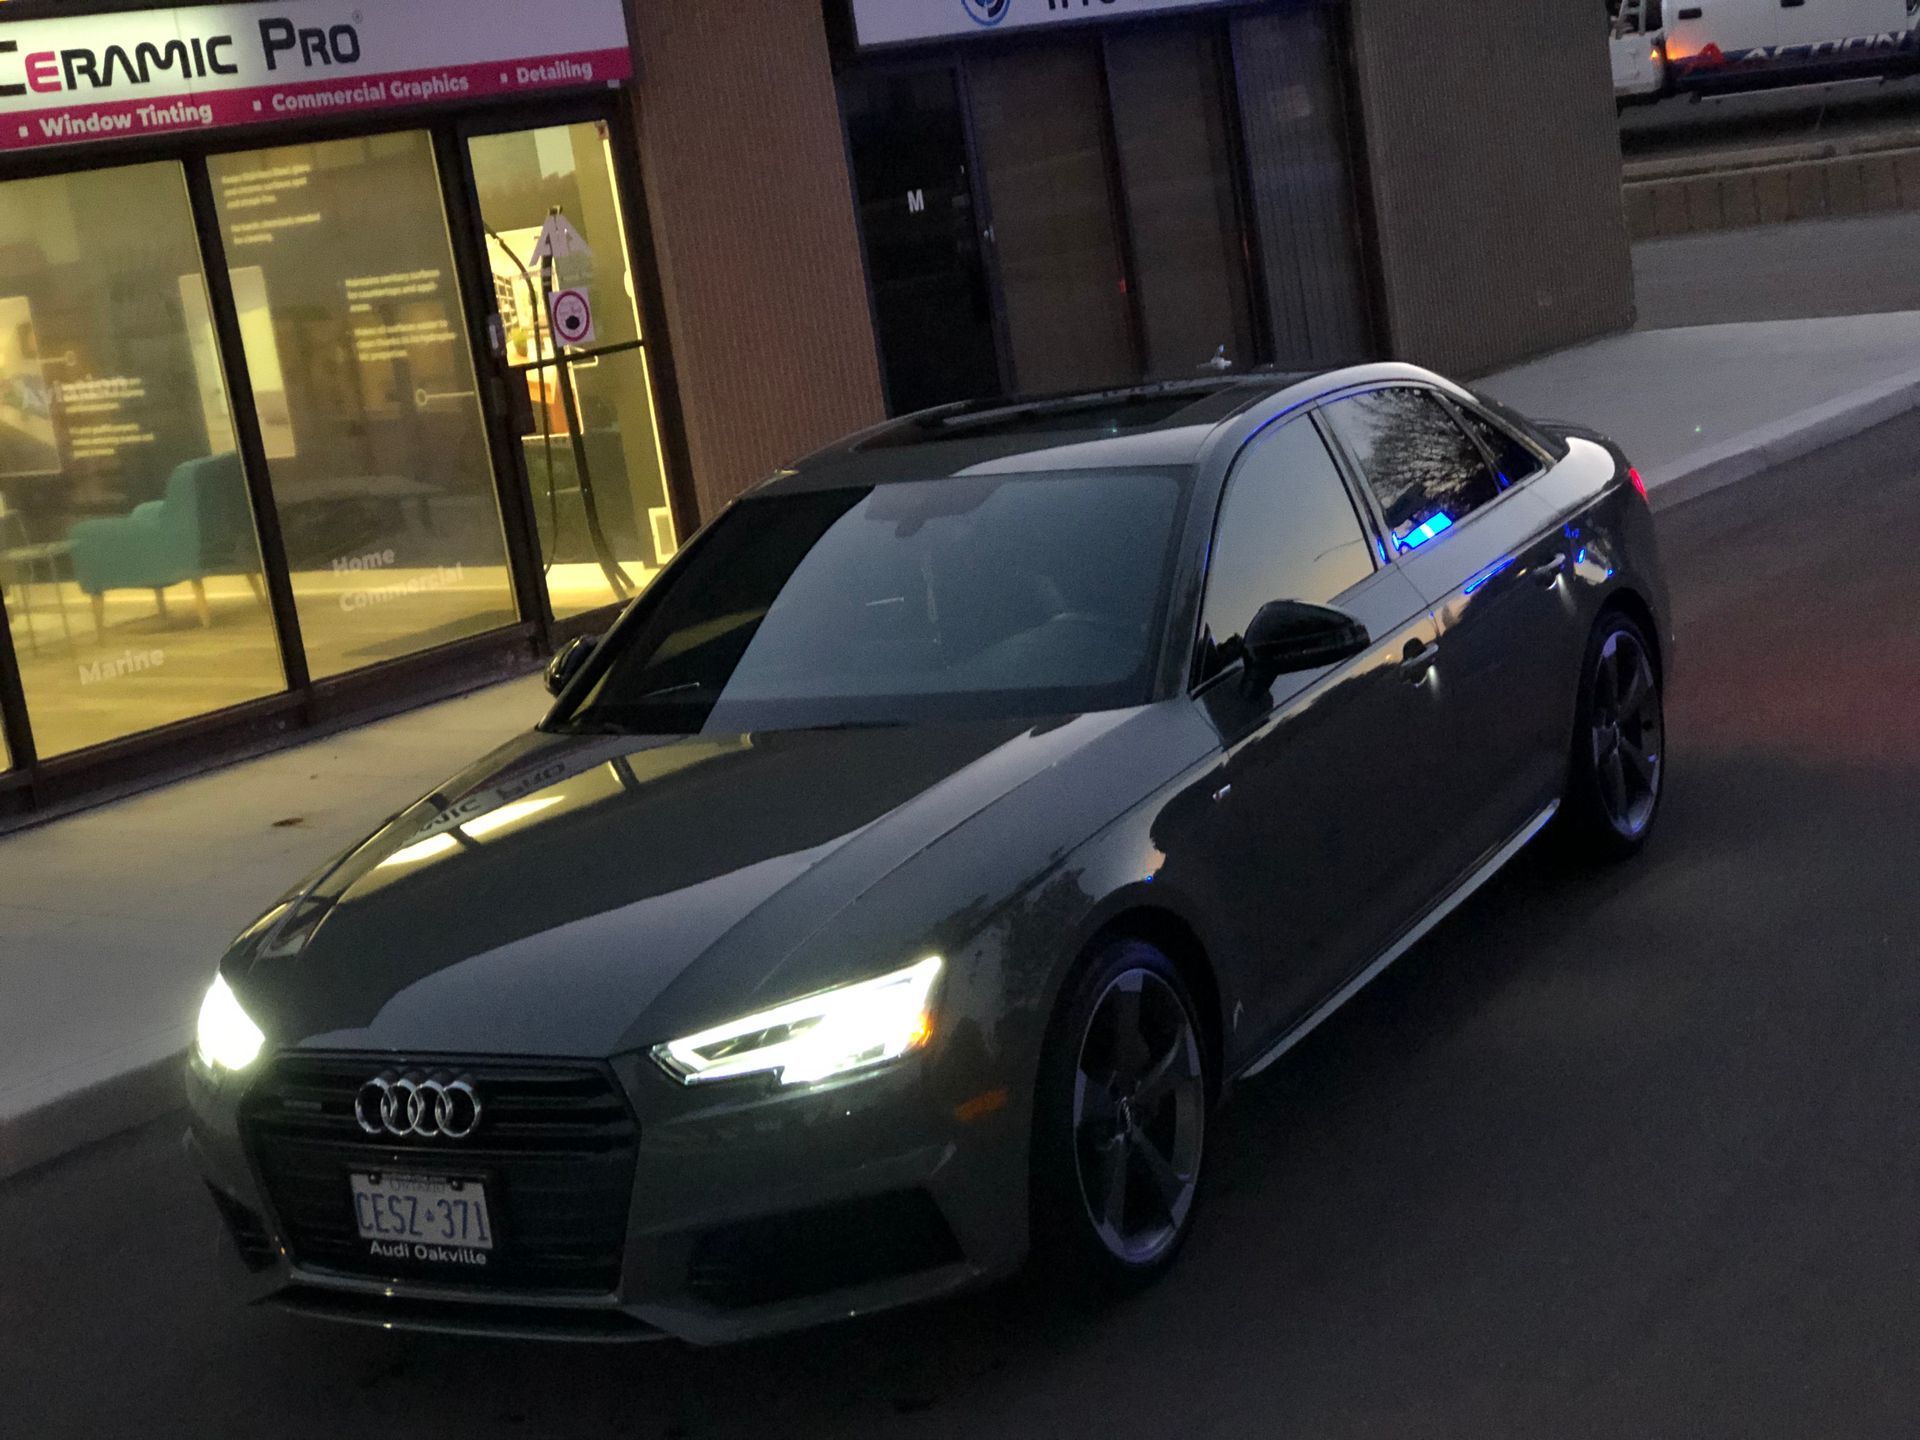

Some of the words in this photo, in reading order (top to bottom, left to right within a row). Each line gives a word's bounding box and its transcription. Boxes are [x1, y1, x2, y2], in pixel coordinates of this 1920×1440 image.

[259, 17, 360, 70] PRO
[516, 59, 593, 83] Detailing
[272, 82, 386, 111] Commercial
[390, 73, 469, 99] Graphics
[40, 112, 131, 137] Window
[136, 101, 212, 125] Tinting
[332, 548, 395, 577] Home
[340, 561, 464, 612] Commercial
[78, 648, 165, 686] Marine
[370, 1239, 410, 1259] Audi
[414, 1245, 487, 1265] Oakville
